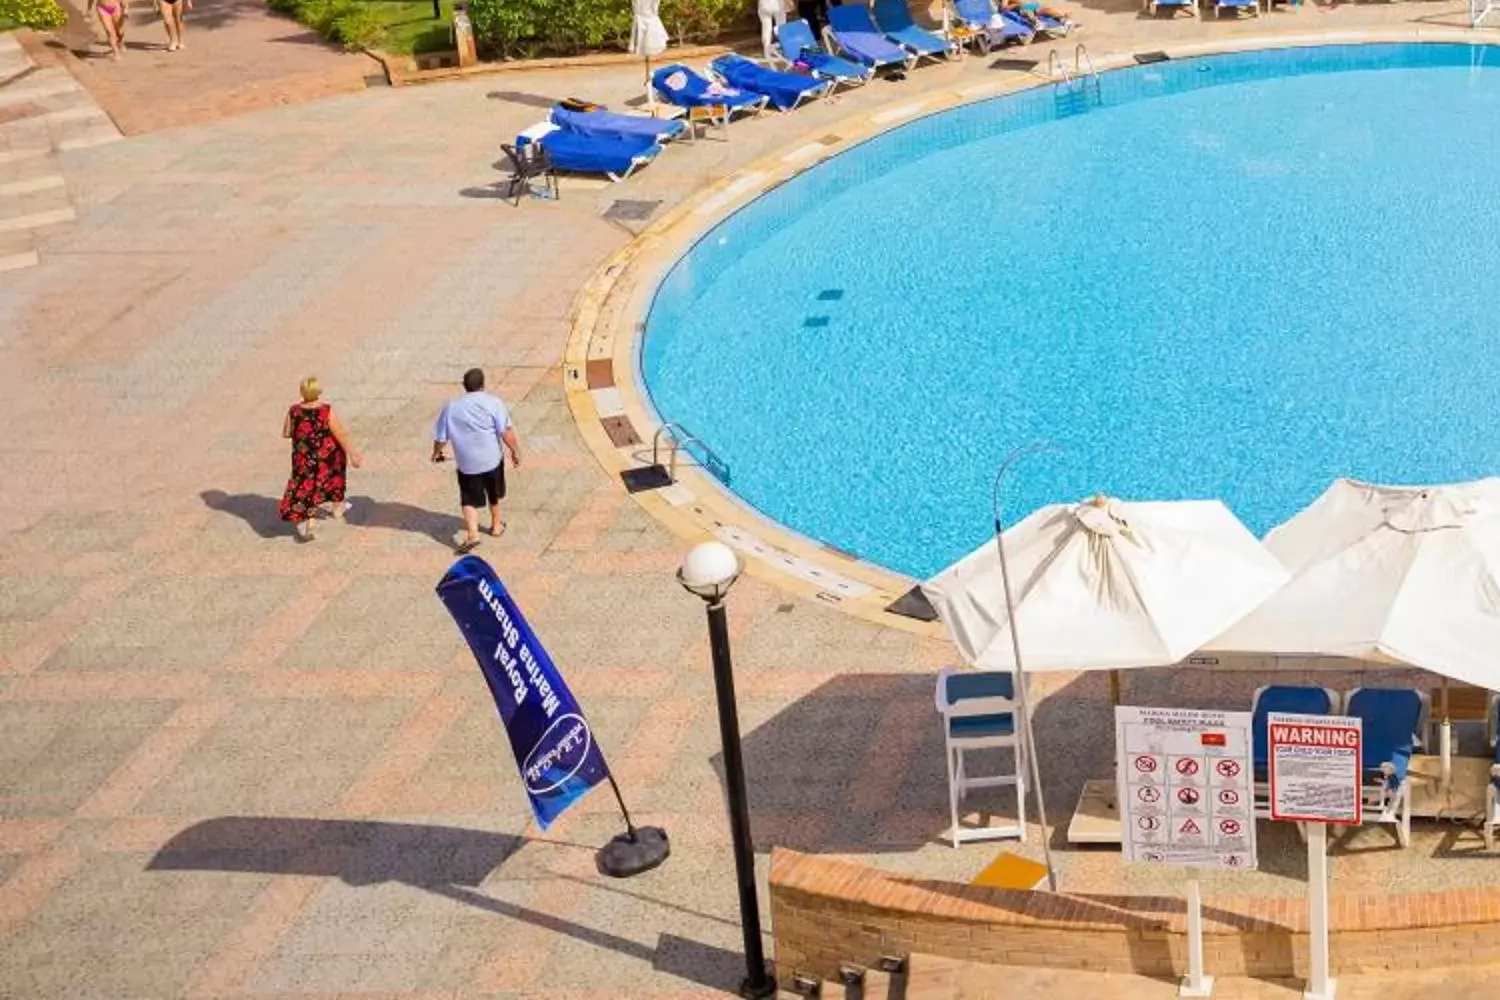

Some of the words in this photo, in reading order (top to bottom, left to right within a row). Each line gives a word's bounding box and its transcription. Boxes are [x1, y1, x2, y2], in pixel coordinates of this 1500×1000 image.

[478, 578, 519, 649] Sharm
[494, 641, 529, 706] Royal
[519, 643, 561, 718] Marina
[1273, 727, 1358, 746] WARNING
